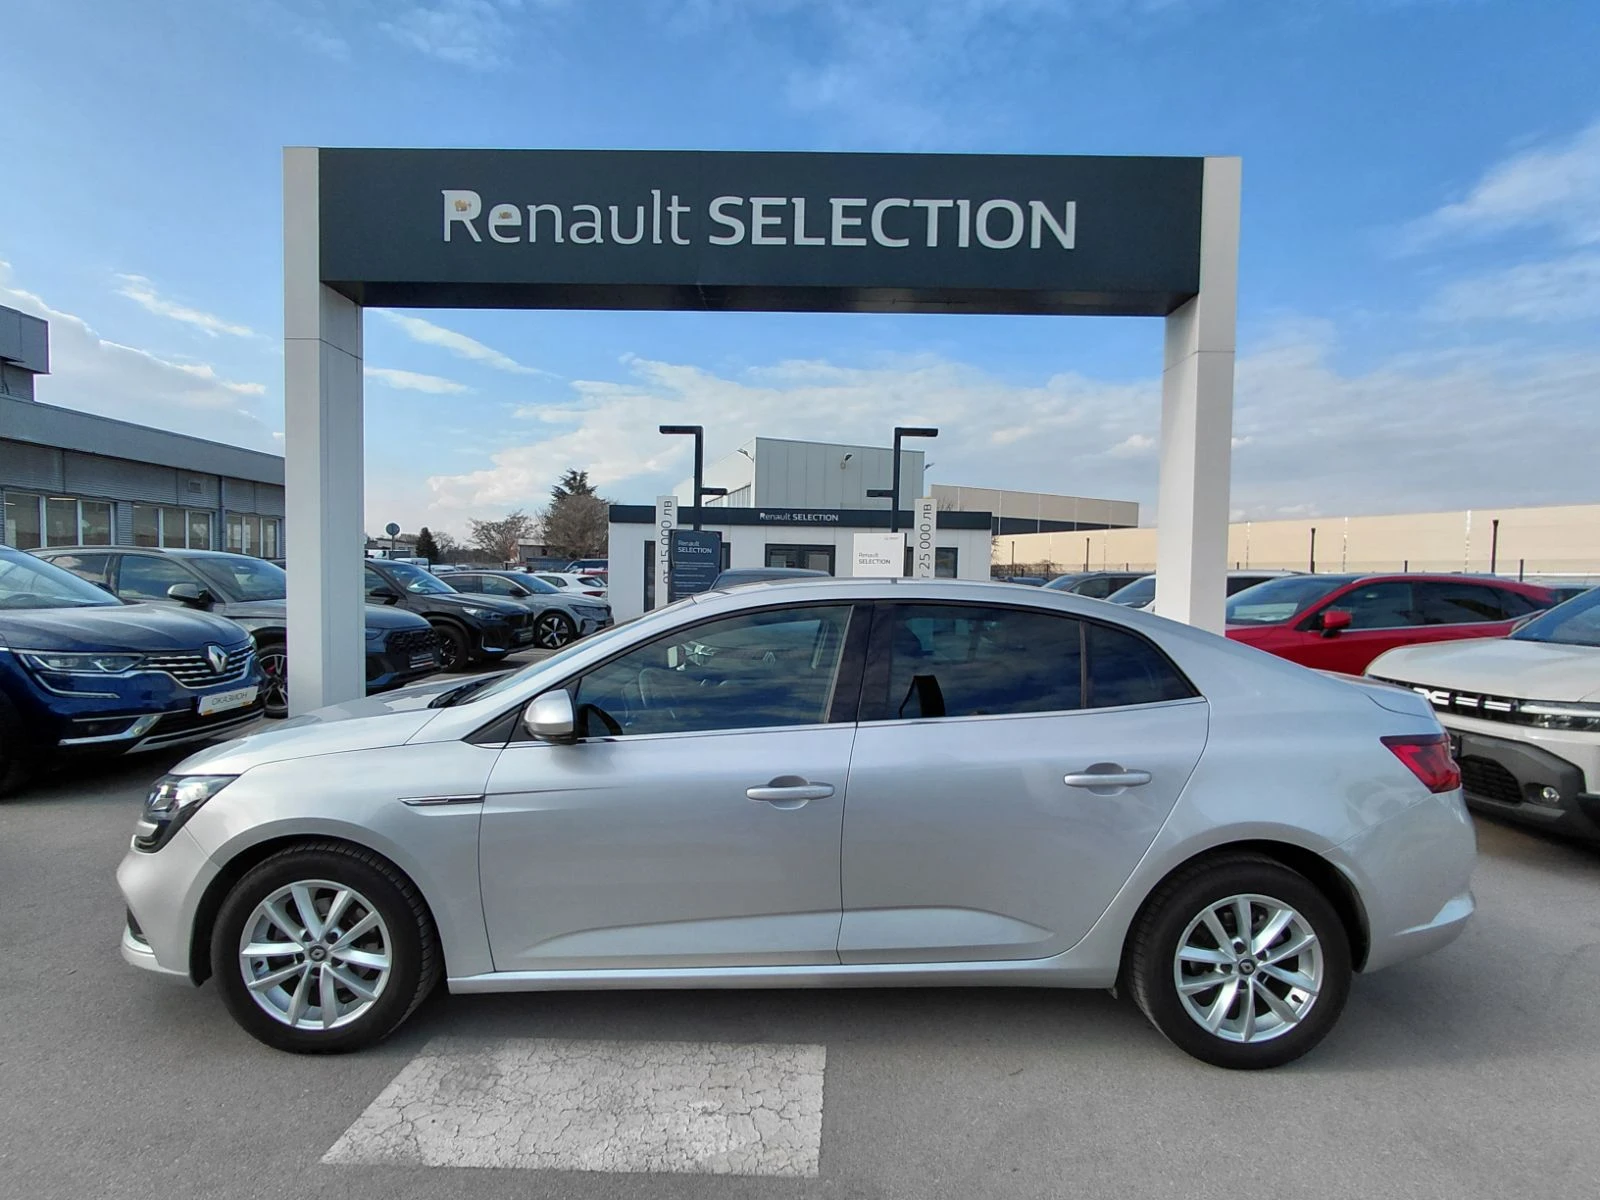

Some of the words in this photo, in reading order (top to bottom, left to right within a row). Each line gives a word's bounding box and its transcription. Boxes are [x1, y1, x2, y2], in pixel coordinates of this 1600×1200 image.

[441, 189, 691, 246] Renault
[709, 195, 1076, 250] SELECTION
[759, 512, 791, 521] Renault
[792, 513, 839, 522] SELECTION
[923, 503, 932, 521] лв
[920, 523, 931, 550] 000
[919, 553, 931, 570] 25
